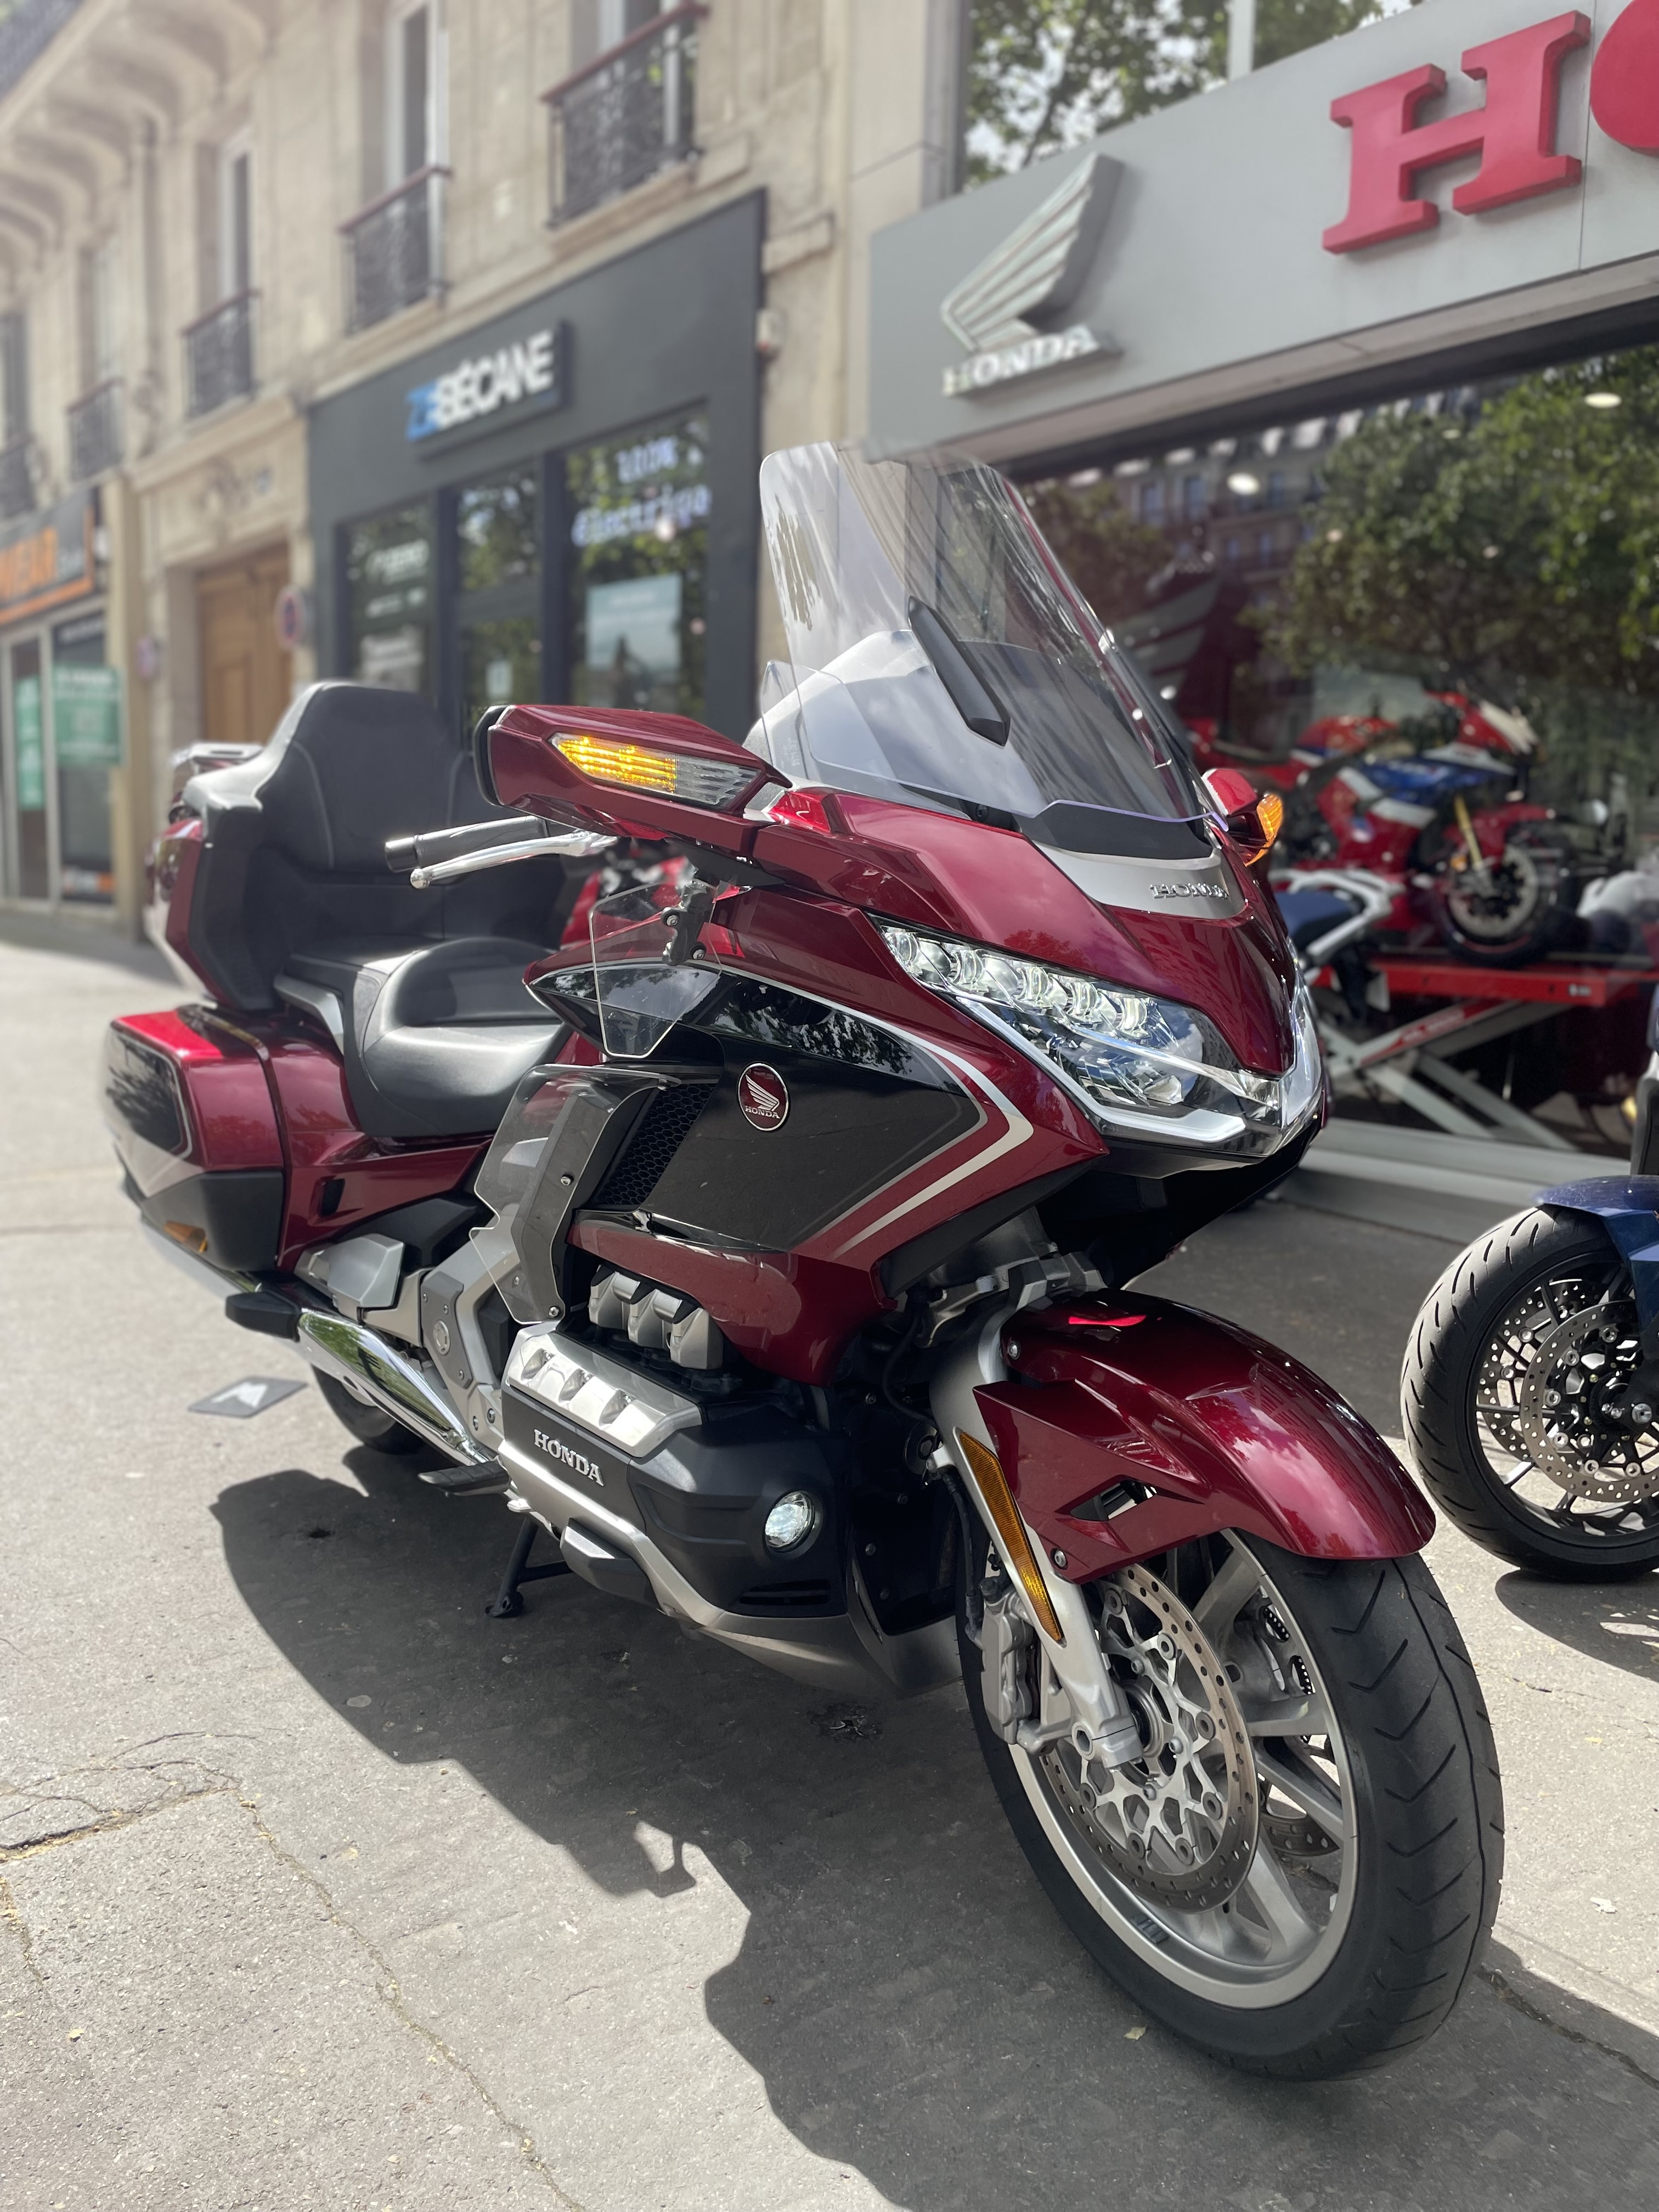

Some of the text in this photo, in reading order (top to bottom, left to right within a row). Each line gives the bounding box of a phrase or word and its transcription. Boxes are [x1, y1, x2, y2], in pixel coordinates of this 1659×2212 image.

[941, 323, 1099, 396] HONDA
[1150, 883, 1229, 899] HONDA
[744, 1105, 780, 1119] HONDA
[534, 1429, 604, 1486] HONDA
